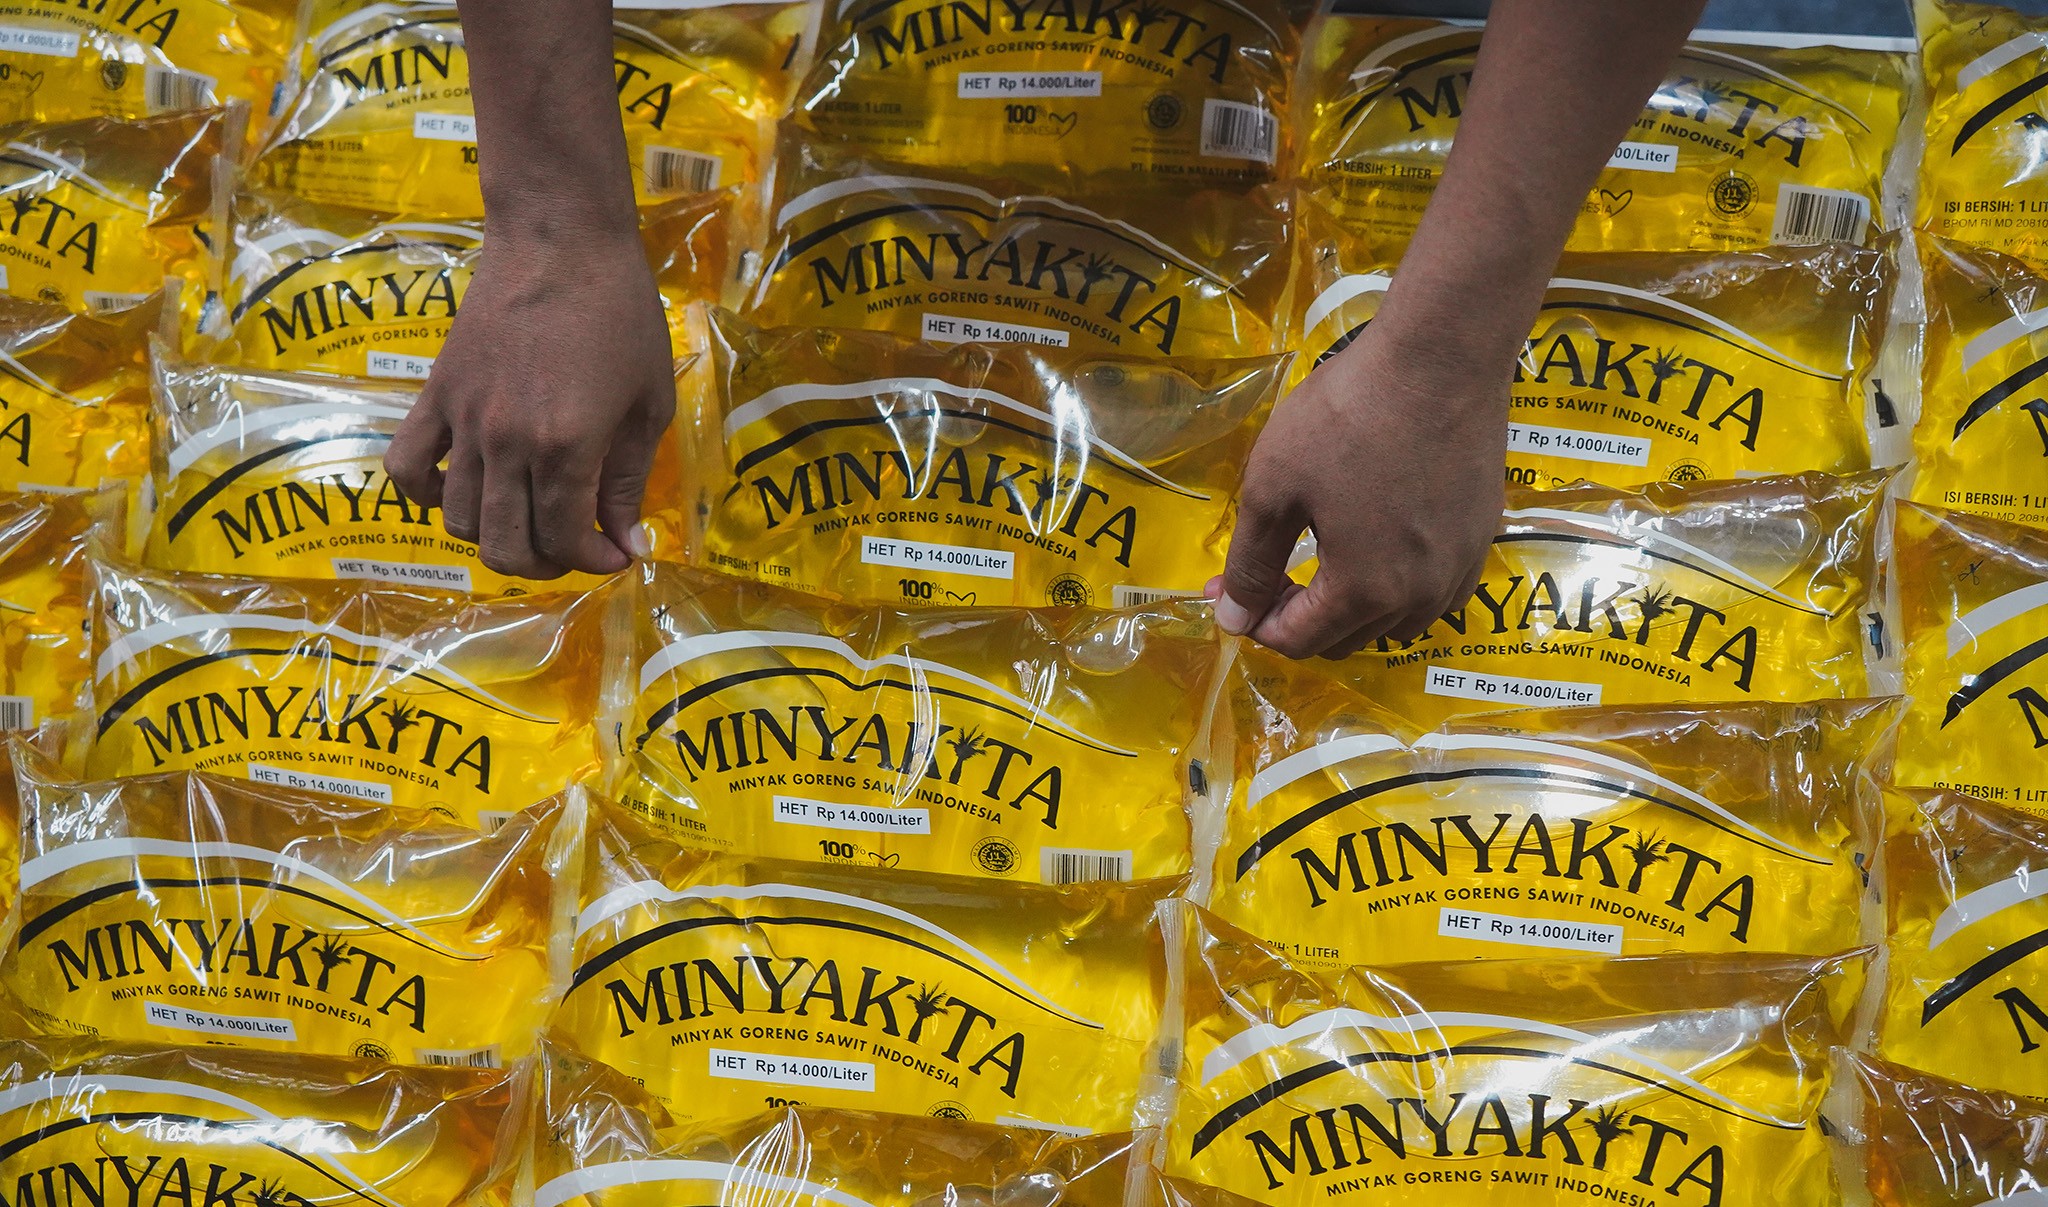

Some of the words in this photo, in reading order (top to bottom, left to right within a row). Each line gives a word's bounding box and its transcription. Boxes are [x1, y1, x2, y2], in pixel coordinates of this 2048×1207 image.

[925, 48, 980, 71] MINYAK
[985, 41, 1046, 54] GORENG
[1051, 40, 1095, 55] SAWIT
[1099, 47, 1176, 79] INDONESIA
[964, 77, 991, 90] HET
[998, 78, 1017, 92] Rp
[1020, 76, 1097, 91] 14.000/Liter
[421, 120, 446, 131] HET
[452, 121, 470, 134] Rp
[1660, 122, 1746, 160] INDONESIA
[1611, 146, 1671, 163] 00/Liter
[1390, 165, 1397, 176] 1
[1400, 167, 1432, 180] LITER
[1944, 201, 1961, 213] ISI
[1964, 201, 2015, 213] BERSIH:
[2019, 201, 2026, 213] 1
[1995, 219, 2014, 228] MD
[809, 233, 1182, 356] MINYAKITA
[866, 293, 924, 315] MINYAK
[928, 291, 989, 305] GORENG
[994, 294, 1041, 313] SAWIT
[1044, 305, 1122, 346] INDONESIA
[928, 319, 956, 335] HET
[963, 322, 982, 340] Rp
[985, 327, 1063, 346] 14.000/Liter
[317, 335, 367, 358] MINYAK
[373, 328, 429, 343] GORENG
[374, 358, 399, 371] HET
[406, 358, 424, 374] Rp
[1555, 396, 1609, 415] SAWIT
[1612, 406, 1701, 446] INDONESIA
[1528, 430, 1550, 448] Rp
[1555, 435, 1644, 457] 14.000/Liter
[751, 447, 1137, 569] MINYAKITA
[1944, 491, 1961, 503] ISI
[1965, 492, 2018, 507] BERSIH:
[2022, 494, 2030, 507] 1
[275, 538, 325, 561] MINYAK
[329, 533, 386, 548] GORENG
[391, 533, 436, 549] SAWIT
[439, 539, 480, 559] INDO
[813, 512, 872, 535] MINYAK
[877, 511, 939, 524] GORENG
[944, 512, 994, 532] SAWIT
[996, 521, 1078, 562] INDONESIA
[718, 553, 752, 572] BERSIH:
[753, 560, 760, 573] 1
[763, 564, 791, 578] LITER
[868, 542, 897, 558] HET
[904, 546, 924, 563] Rp
[927, 548, 1008, 571] 14.000/Liter
[338, 562, 365, 575] HET
[371, 564, 390, 578] Rp
[392, 566, 465, 583] 14.000/Liter
[1386, 646, 1454, 669] MINYAK
[1460, 642, 1533, 656] GORENG
[1539, 642, 1595, 659] SAWIT
[1599, 649, 1692, 687] INDONESIA
[1433, 673, 1467, 689] HET
[1474, 679, 1497, 695] Rp
[1502, 682, 1594, 703] 14.000/Liter
[133, 686, 491, 795] MINYAKITA
[195, 752, 244, 770] MINYAK
[248, 750, 304, 762] GORENG
[309, 751, 355, 767] SAWIT
[359, 758, 441, 790] INDONESIA
[674, 706, 1062, 830] MINYAKITA
[254, 769, 281, 783] HET
[288, 775, 308, 788] Rp
[310, 779, 386, 800] 14.000/Liter
[729, 774, 787, 794] MINYAK
[792, 772, 857, 789] GORENG
[915, 787, 1002, 825] INDONESIA
[2013, 787, 2021, 801] 1
[631, 796, 670, 820] BERSIH:
[670, 811, 677, 824] 1
[678, 815, 708, 833] LITER
[780, 801, 809, 816] HET
[816, 806, 836, 822] Rp
[839, 809, 923, 827] 14.000/Liter
[818, 838, 867, 860] 100%
[1290, 813, 1754, 944] MINYAKITA
[1367, 890, 1438, 915] MINYAK
[1443, 887, 1520, 901] GORENG
[1527, 887, 1585, 906] SAWIT
[1589, 897, 1686, 937] INDONESIA
[1447, 914, 1482, 931] HET
[1490, 919, 1514, 936] Rp
[1519, 923, 1615, 945] 14.000/Liter
[1293, 943, 1301, 955] 1
[1305, 946, 1340, 960] LITER
[46, 918, 426, 1034] MINYAKITA
[111, 984, 164, 1001] MINYAK
[168, 984, 229, 998] GORENG
[233, 986, 282, 1003] SAWIT
[286, 994, 372, 1028] INDONESIA
[151, 1007, 178, 1021] HET
[186, 1013, 205, 1027] Rp
[208, 1016, 289, 1034] 14.000/Liter
[72, 1020, 100, 1036] LITER
[604, 955, 1025, 1100] MINYAKITA
[671, 1027, 734, 1047] MINYAK
[740, 1026, 809, 1042] GORENG
[815, 1031, 868, 1052] SAWIT
[871, 1043, 960, 1089] INDONESIA
[716, 1055, 748, 1070] HET
[755, 1059, 777, 1075] Rp
[781, 1062, 868, 1082] 14.000/Liter
[1244, 1092, 1724, 1207] MINYAKITA
[1326, 1173, 1398, 1198] MINYAK
[1403, 1169, 1483, 1186] GORENG
[1490, 1169, 1550, 1187] SAWIT
[1554, 1175, 1658, 1207] INDONESIA
